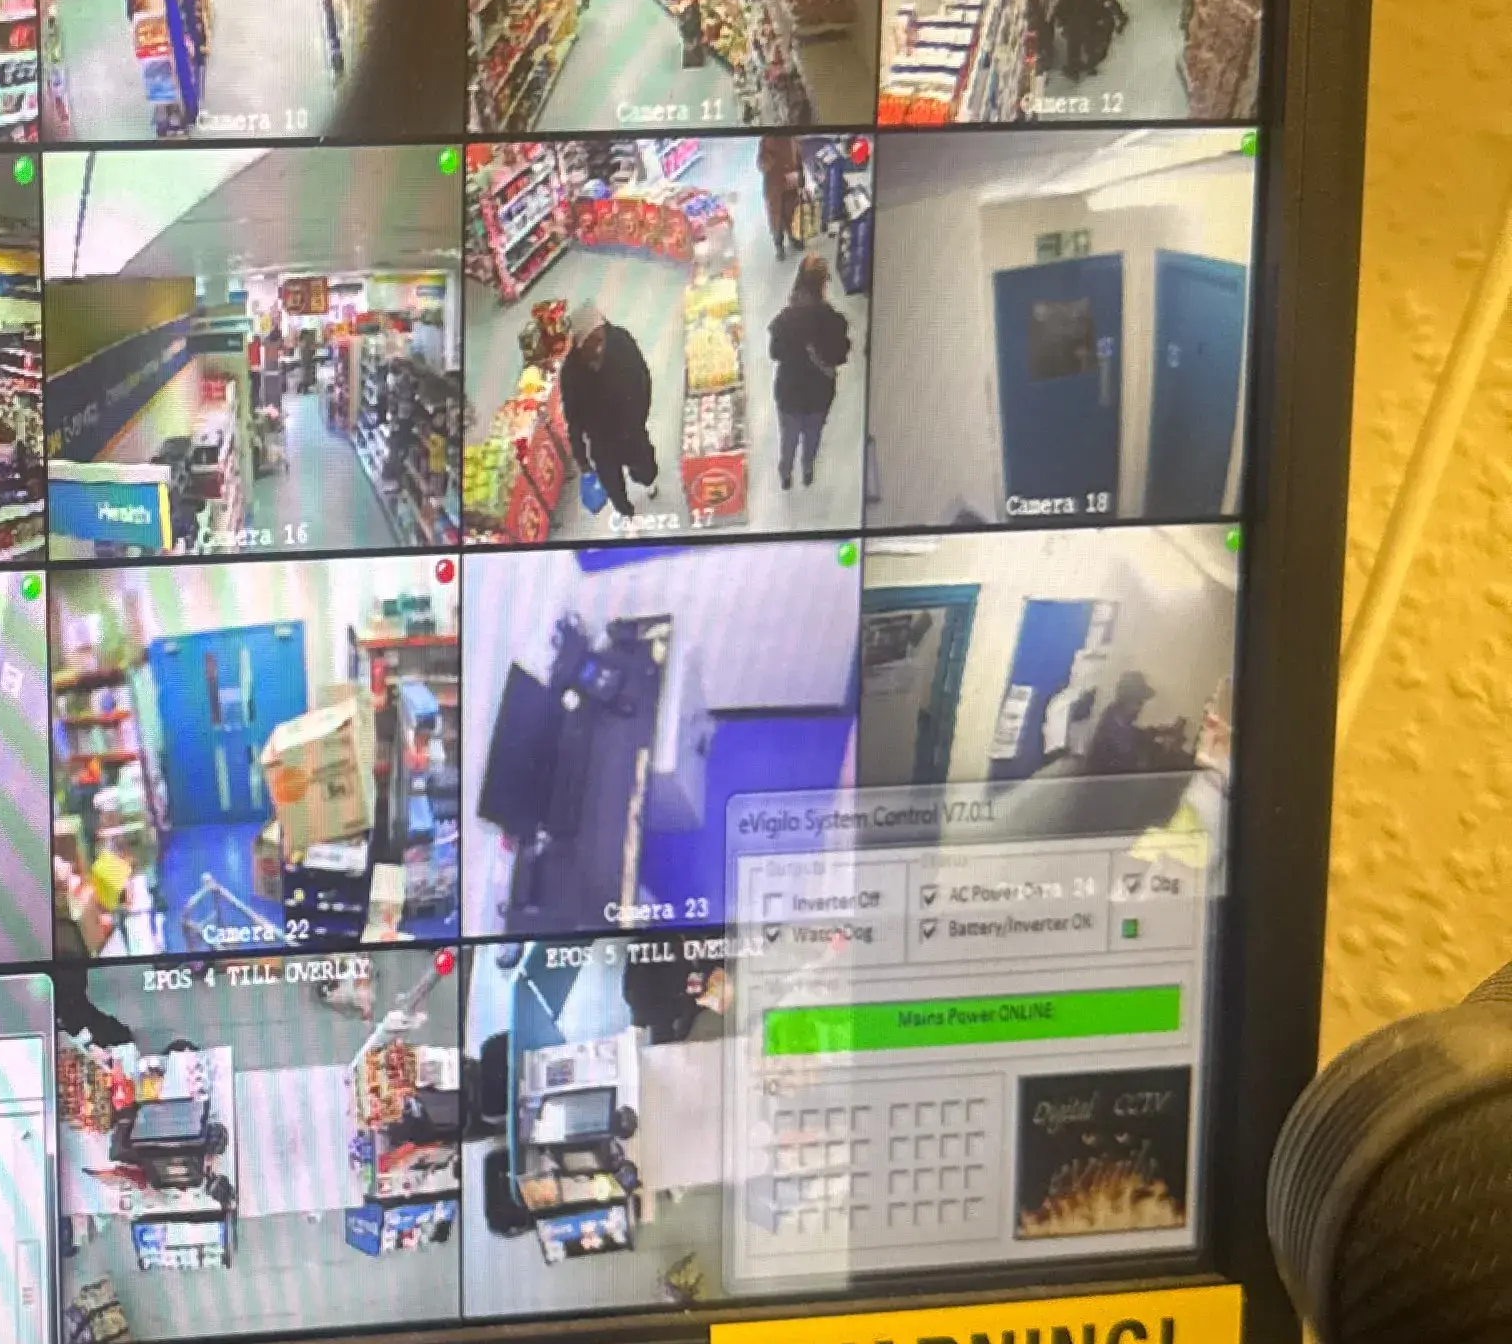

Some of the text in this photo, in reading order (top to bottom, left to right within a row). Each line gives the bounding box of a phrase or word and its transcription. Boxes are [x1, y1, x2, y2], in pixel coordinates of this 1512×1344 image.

[617, 98, 725, 123] Camera 11
[1020, 91, 1124, 115] Camera 12
[198, 106, 308, 130] Camera 10
[1006, 491, 1109, 516] Camera 18
[609, 506, 715, 533] Camera 17
[284, 523, 309, 545] 16
[738, 803, 939, 840] eVigilo System Control
[603, 897, 709, 923] Camera 23
[792, 892, 855, 913] Inverter
[202, 918, 310, 945] Camera 22
[948, 914, 1068, 939] Battery/Inverter
[545, 940, 675, 969] EPOS TILL
[143, 957, 370, 992] EPOS 4 TILL OVERLAY
[897, 1001, 1053, 1029] Mains Power ONLINE
